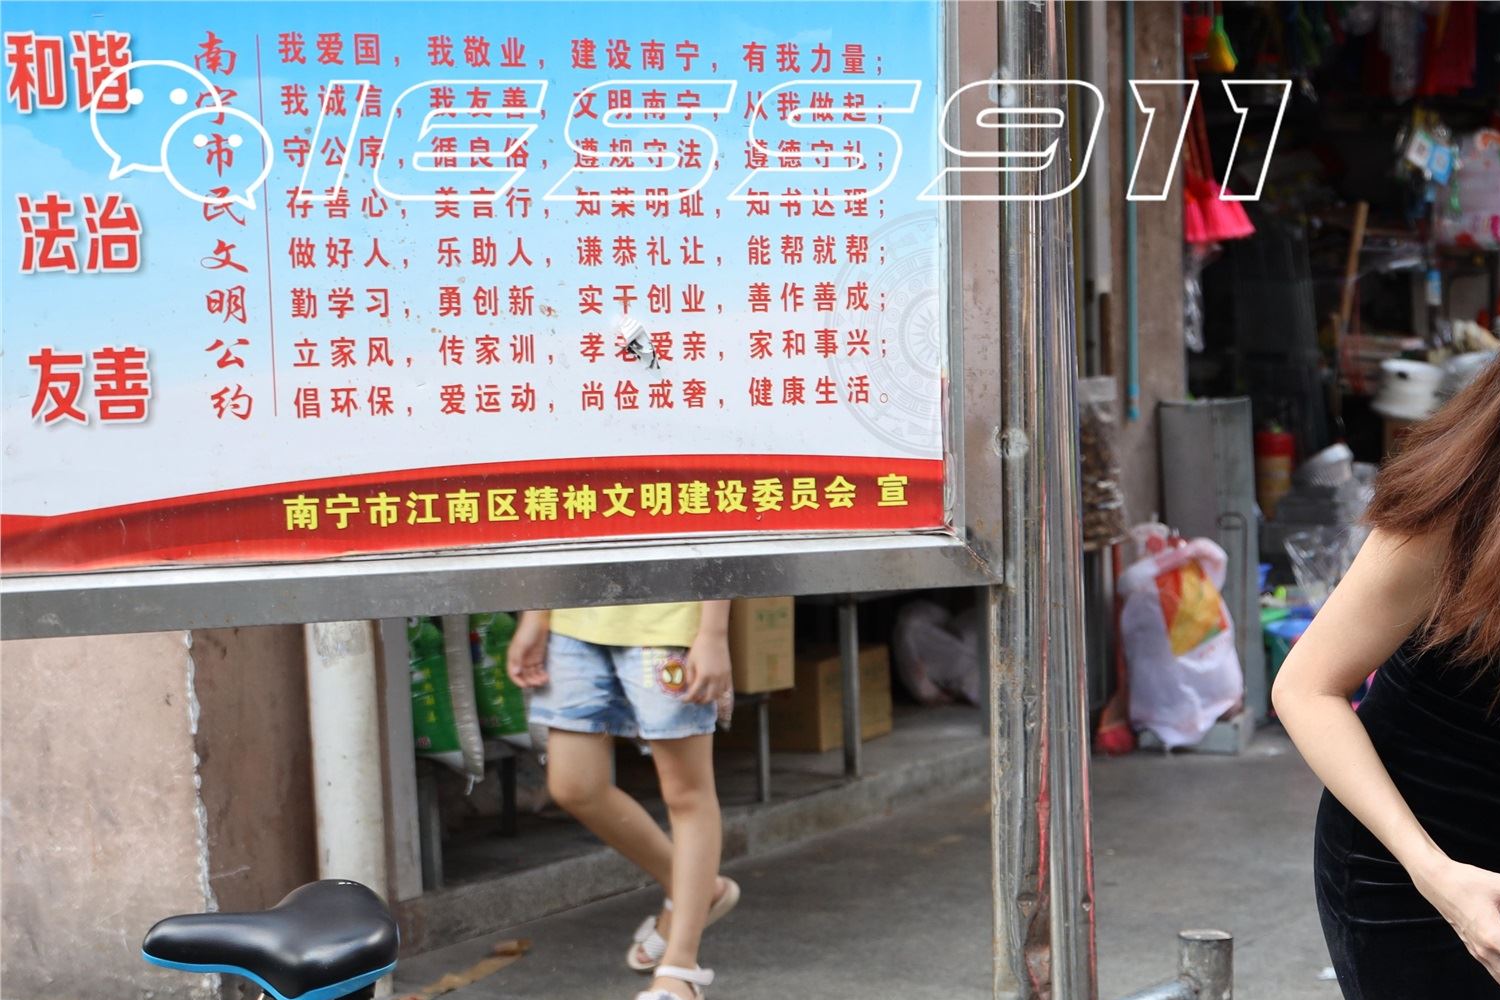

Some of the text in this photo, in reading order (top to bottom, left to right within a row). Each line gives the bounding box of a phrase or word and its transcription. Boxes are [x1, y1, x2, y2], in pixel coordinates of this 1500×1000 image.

[7, 34, 129, 110] 和谐
[19, 194, 141, 271] 法治
[194, 31, 253, 420] 南宁市民文明公约
[28, 346, 150, 424] 友善
[283, 474, 909, 531] 南宁市江南区精神文明建设委员会 宣
